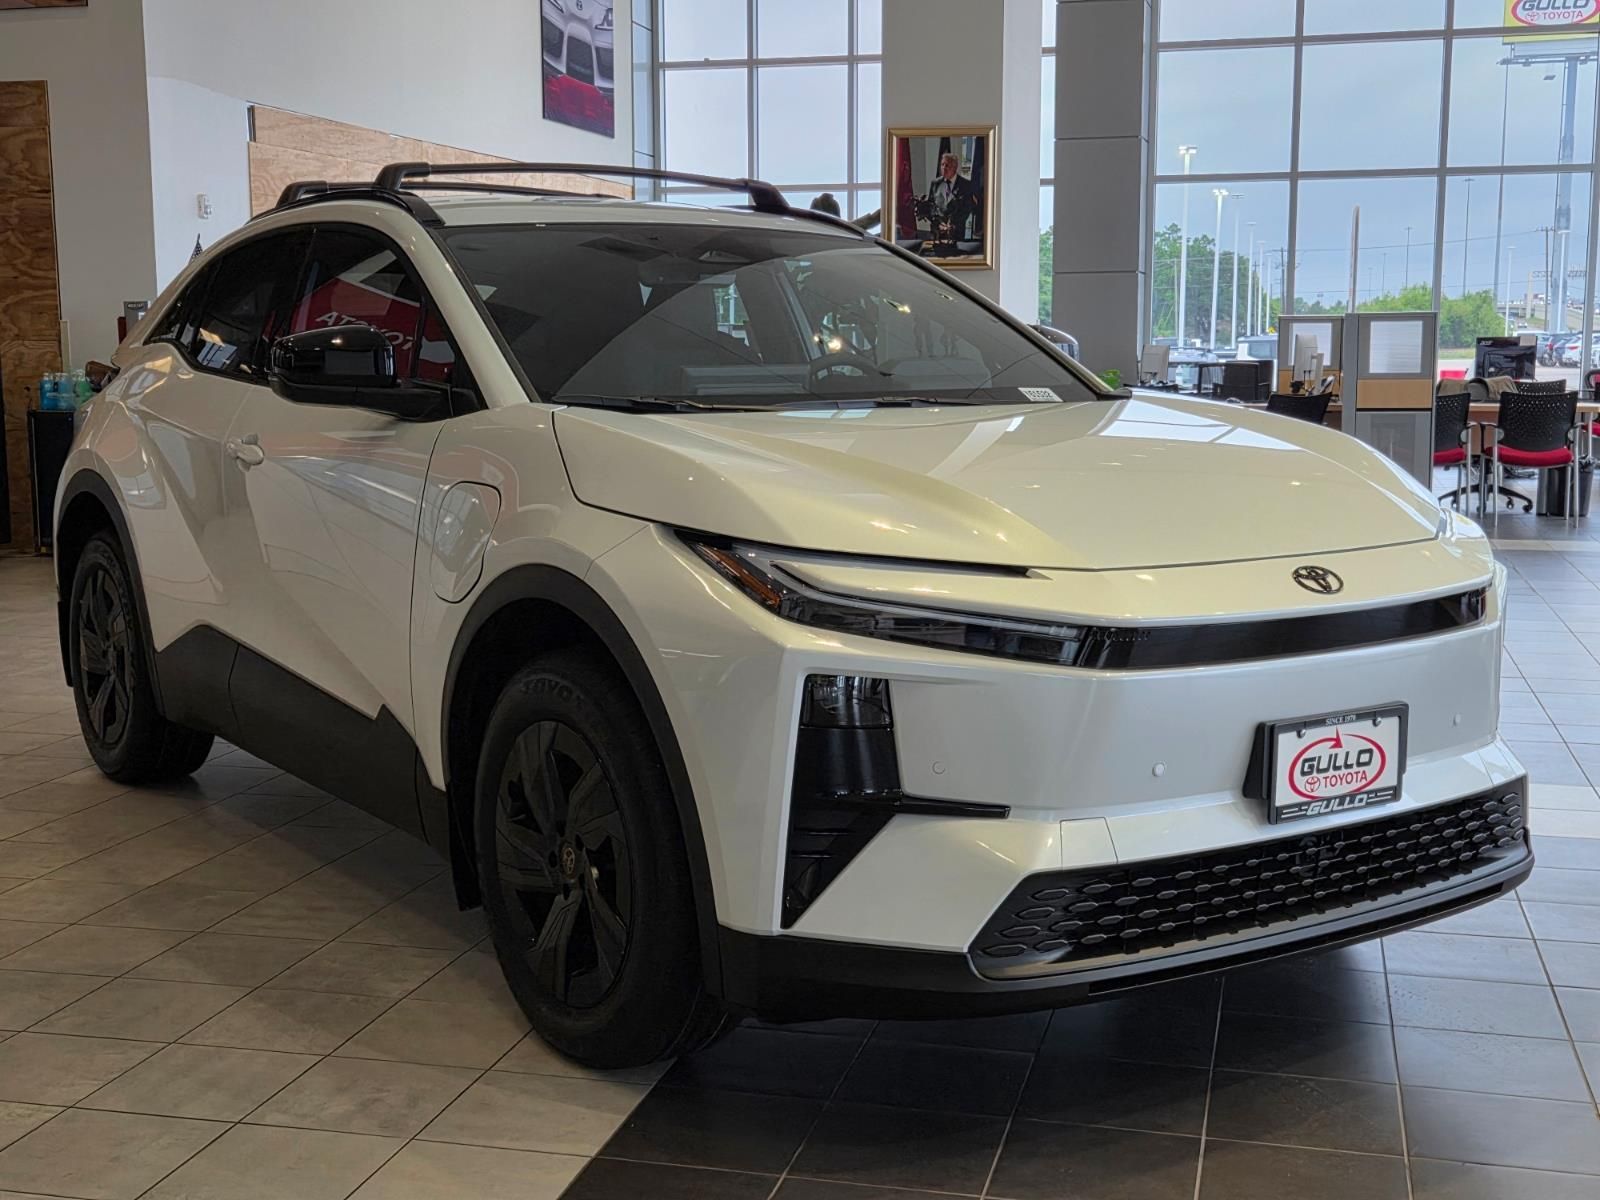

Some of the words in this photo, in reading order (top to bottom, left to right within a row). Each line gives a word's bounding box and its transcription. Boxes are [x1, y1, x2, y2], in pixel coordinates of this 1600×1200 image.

[1542, 11, 1584, 20] TOYOTA
[1325, 716, 1344, 726] SINCE
[1300, 748, 1374, 777] GULLO
[1323, 770, 1368, 788] TOYOTA
[1306, 794, 1368, 815] GULLO
